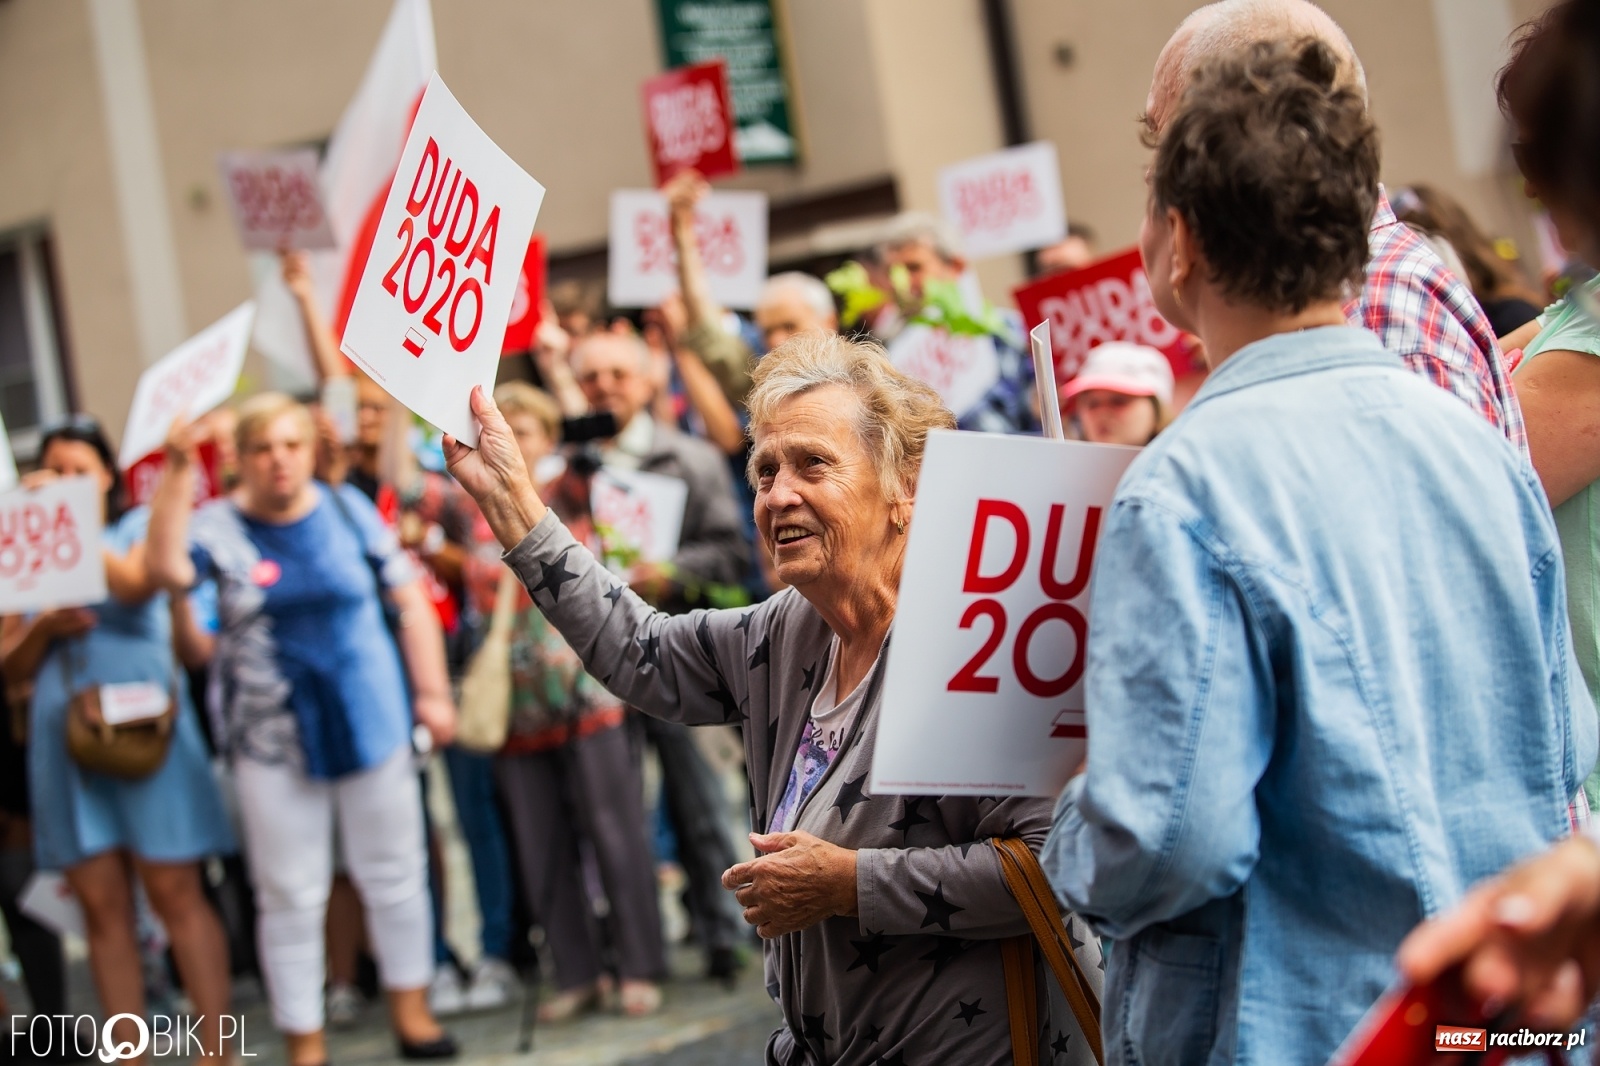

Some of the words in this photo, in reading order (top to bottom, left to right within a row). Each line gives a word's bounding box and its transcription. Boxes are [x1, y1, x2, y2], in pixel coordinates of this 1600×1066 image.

[405, 136, 500, 286] DUDA
[381, 217, 484, 352] 2020
[0, 499, 78, 547] UDA
[0, 536, 82, 578] 020
[962, 498, 1102, 601] DU
[946, 598, 1090, 698] 20
